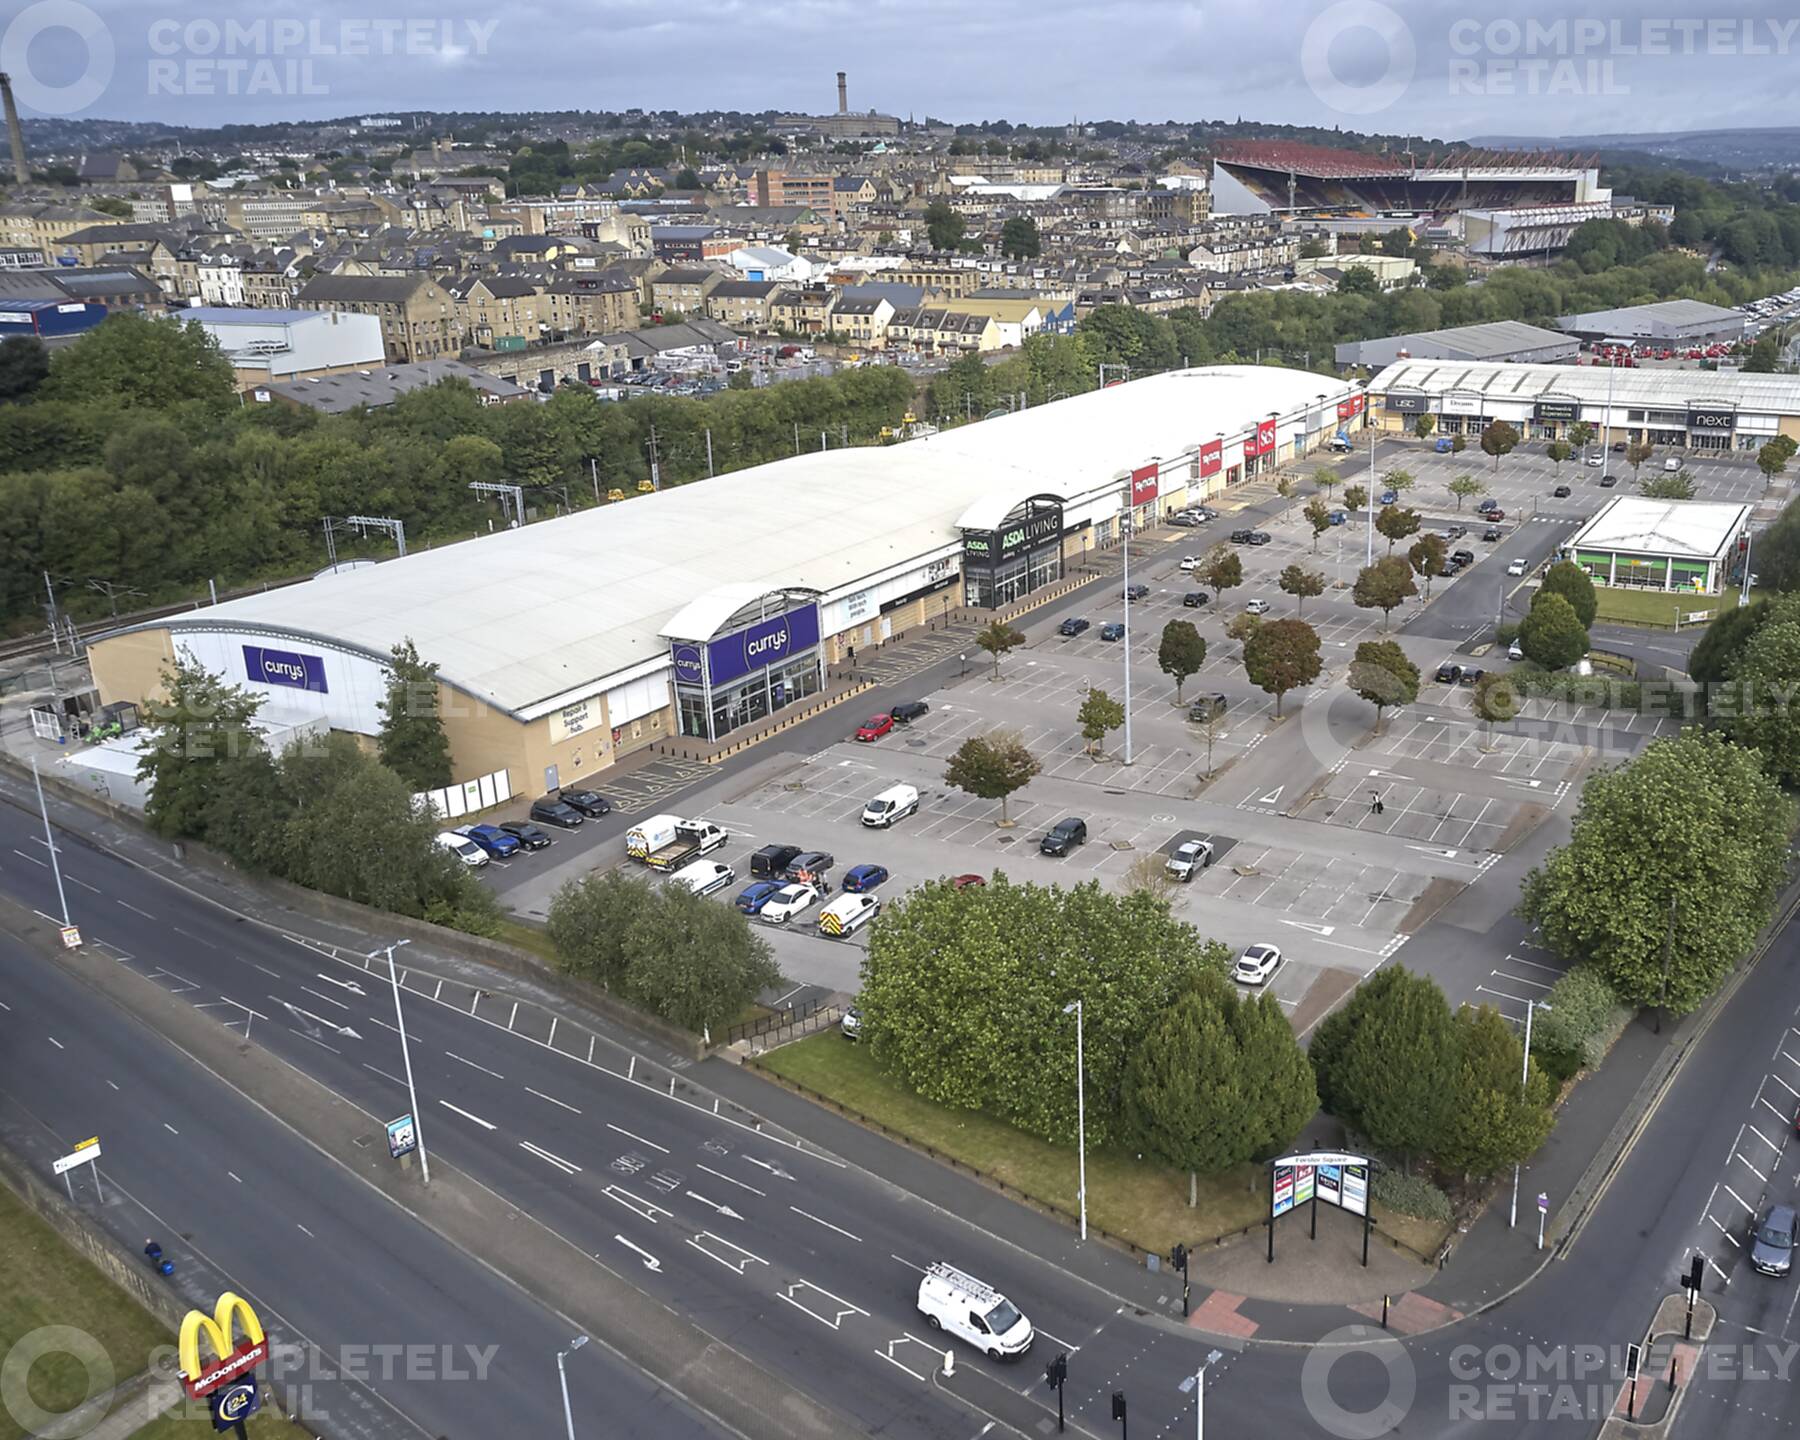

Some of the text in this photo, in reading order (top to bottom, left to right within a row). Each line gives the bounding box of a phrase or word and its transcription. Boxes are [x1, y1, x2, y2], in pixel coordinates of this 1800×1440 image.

[1696, 414, 1731, 427] next
[1002, 528, 1025, 550] ASDA
[1026, 515, 1058, 540] LIVING
[966, 541, 989, 551] ASDA
[966, 550, 991, 559] LIVING
[748, 629, 787, 656] currys
[264, 660, 304, 680] currys
[677, 658, 701, 671] currys
[563, 712, 588, 727] Support
[194, 1347, 262, 1391] McDonald's
[231, 1392, 247, 1408] 24
